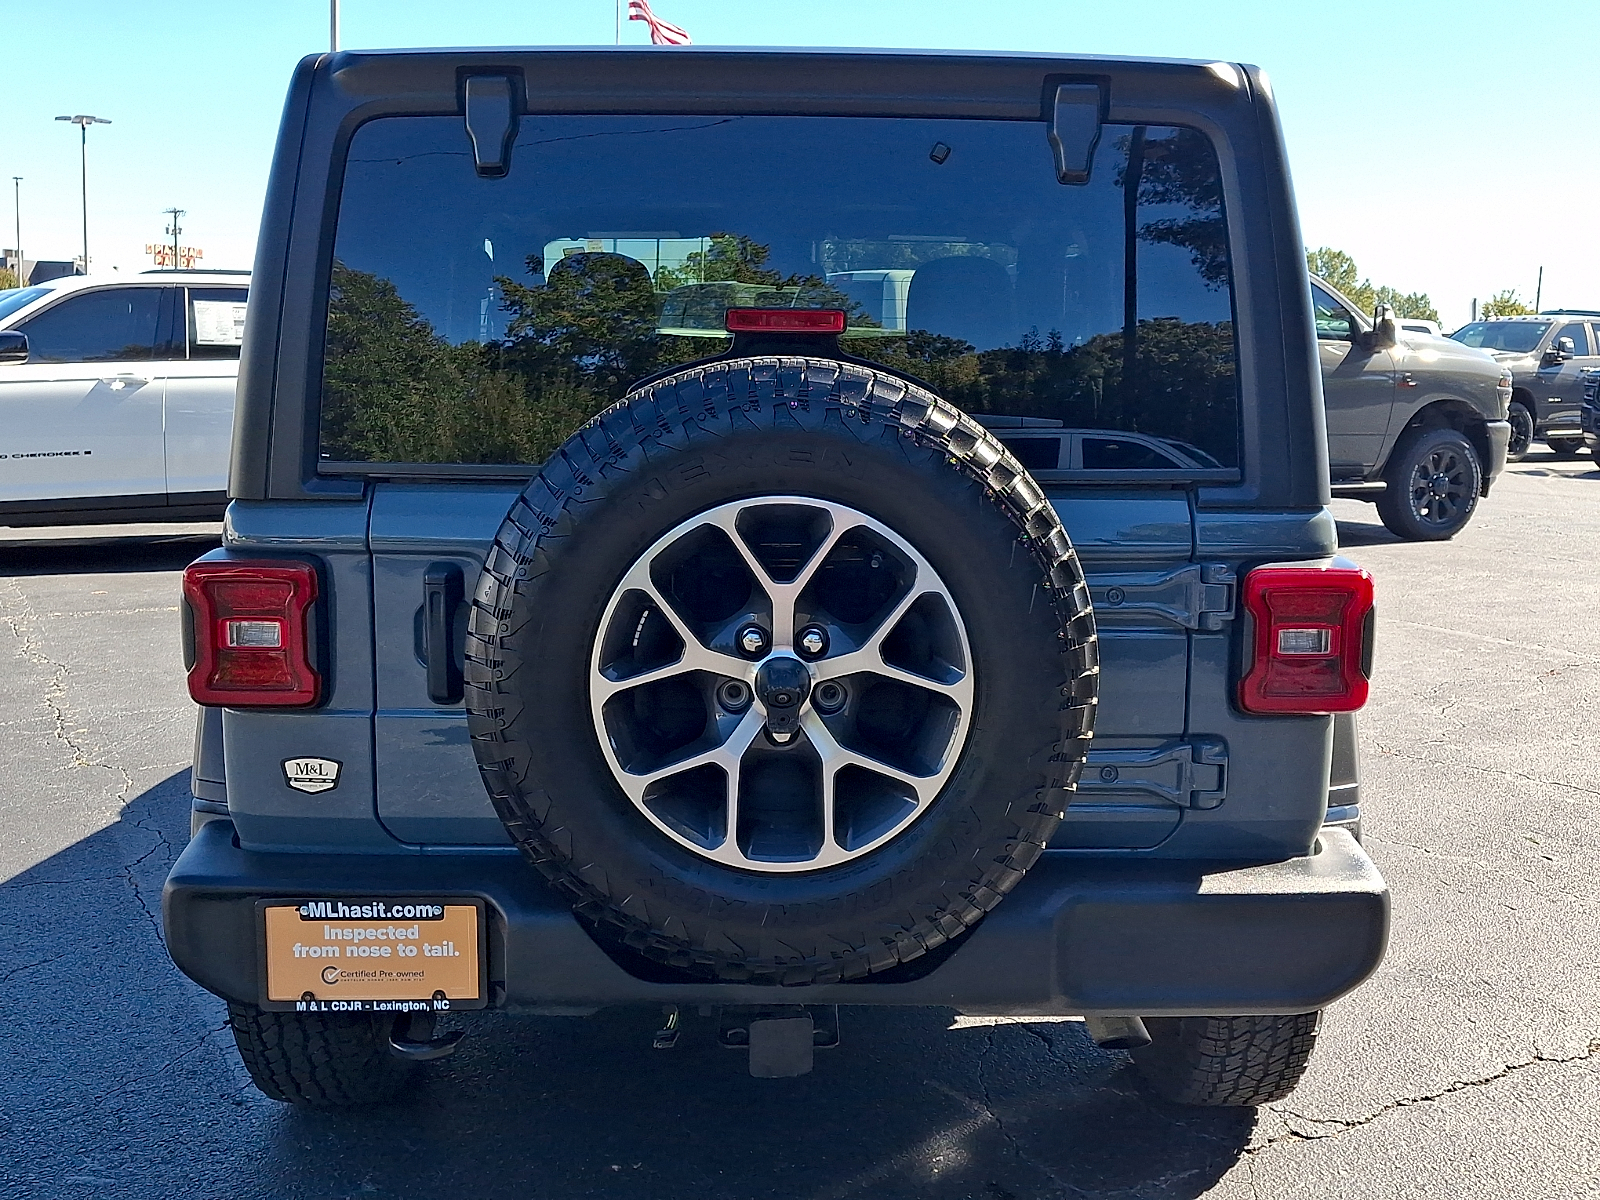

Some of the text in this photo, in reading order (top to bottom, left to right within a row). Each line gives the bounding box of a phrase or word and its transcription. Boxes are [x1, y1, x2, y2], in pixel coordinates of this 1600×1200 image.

[12, 451, 80, 459] CHEROKEE
[295, 762, 329, 776] M&L
[309, 901, 434, 918] MLhasit.com
[324, 925, 419, 943] Inspected
[293, 941, 460, 958] from nose to tail.
[340, 969, 377, 978] Certified
[296, 1001, 306, 1011] M
[309, 1001, 319, 1011] &
[321, 1001, 328, 1011] L
[331, 1000, 363, 1012] CDJR
[373, 1000, 430, 1012] Lexington,
[433, 999, 450, 1011] NC
